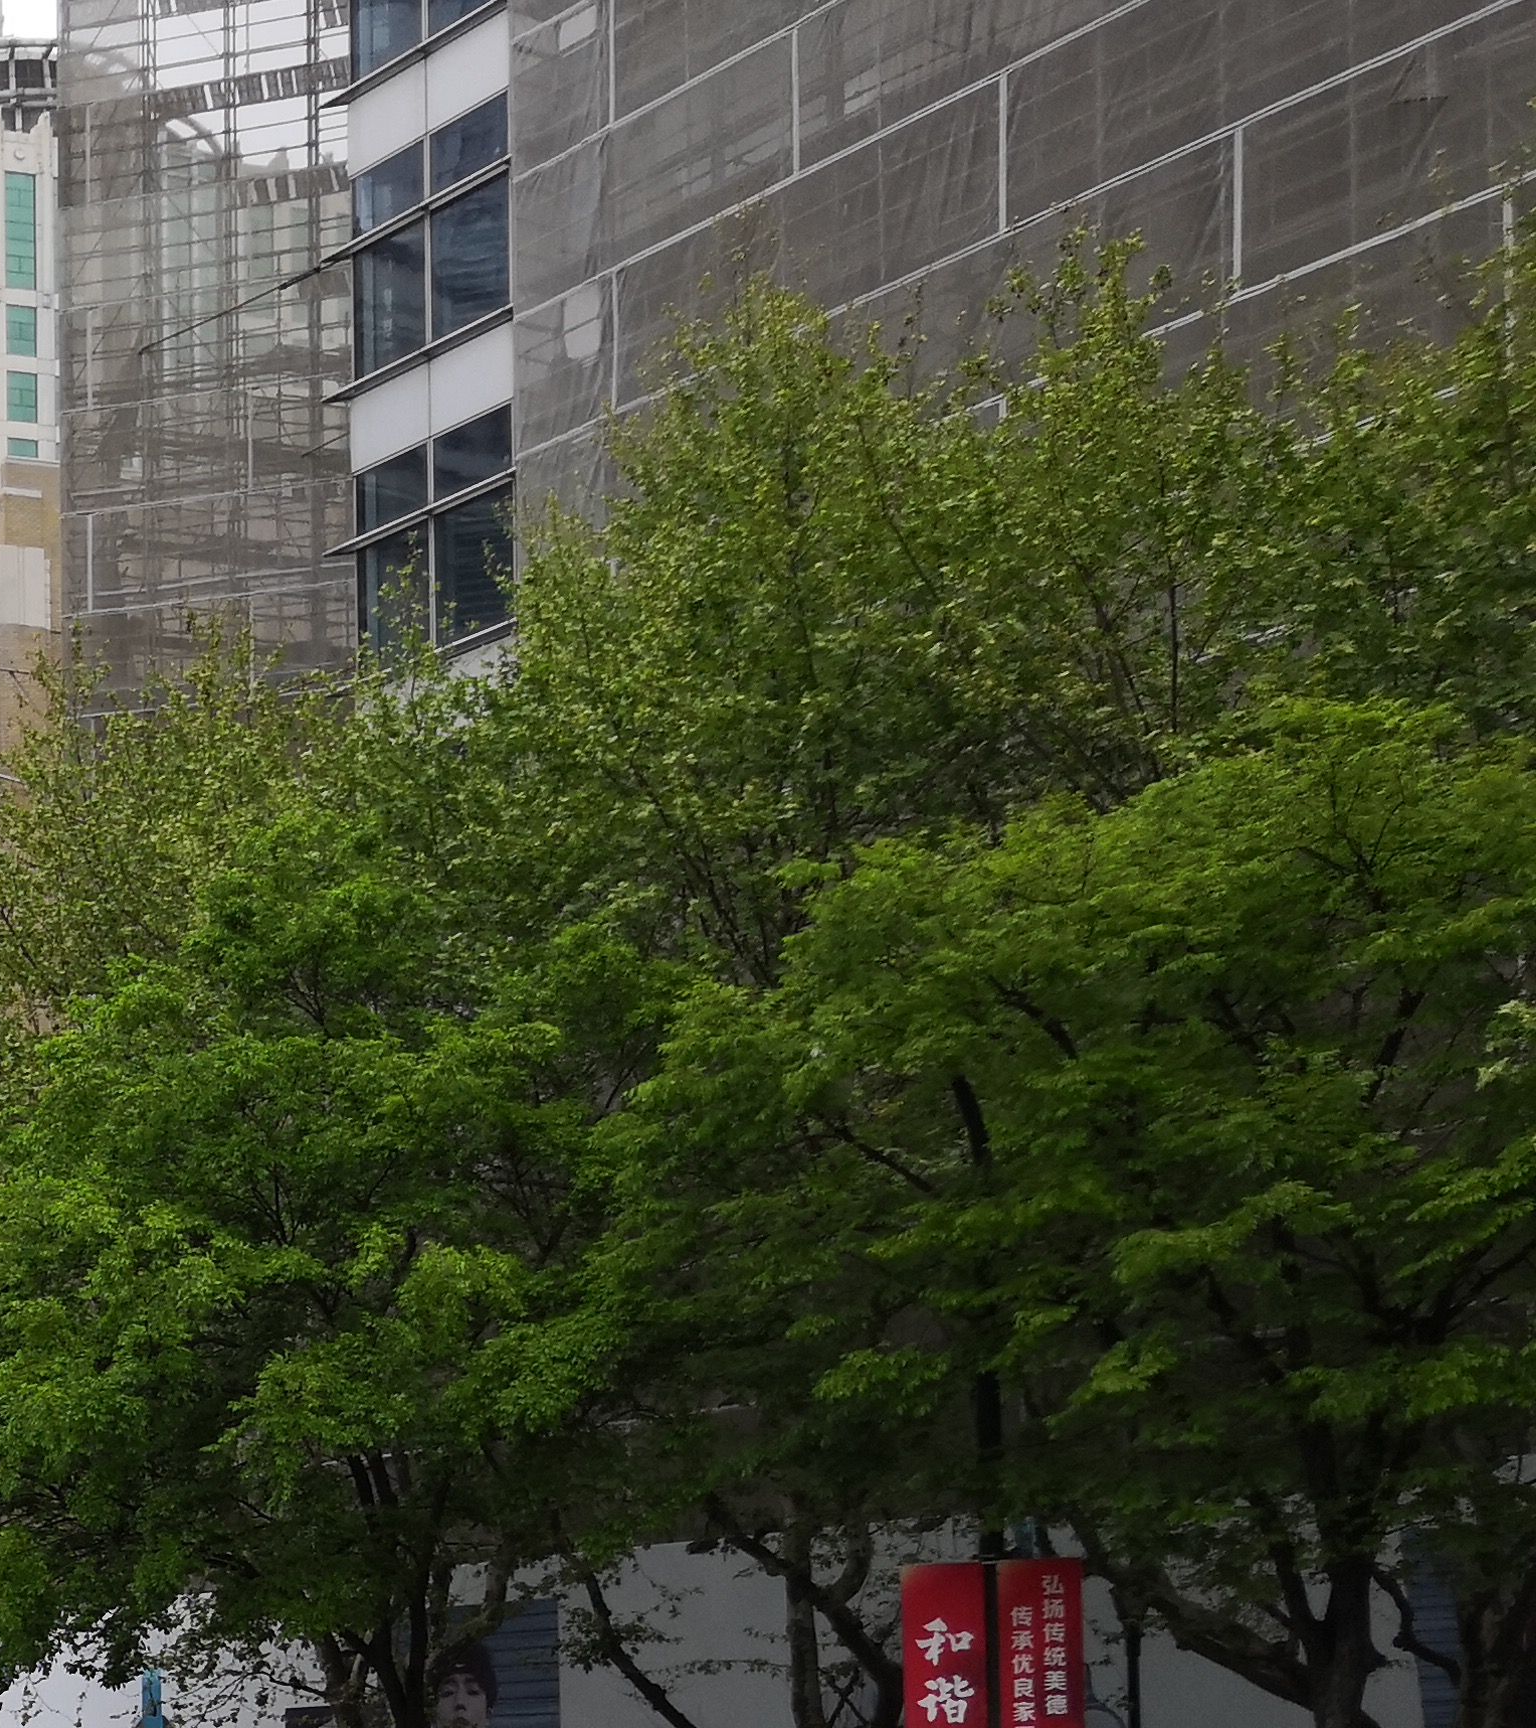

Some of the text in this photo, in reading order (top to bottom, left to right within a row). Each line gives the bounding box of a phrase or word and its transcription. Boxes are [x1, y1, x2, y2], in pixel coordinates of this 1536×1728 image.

[914, 1616, 976, 1725] 和谐
[1041, 1574, 1069, 1717] 弘扬传统美德
